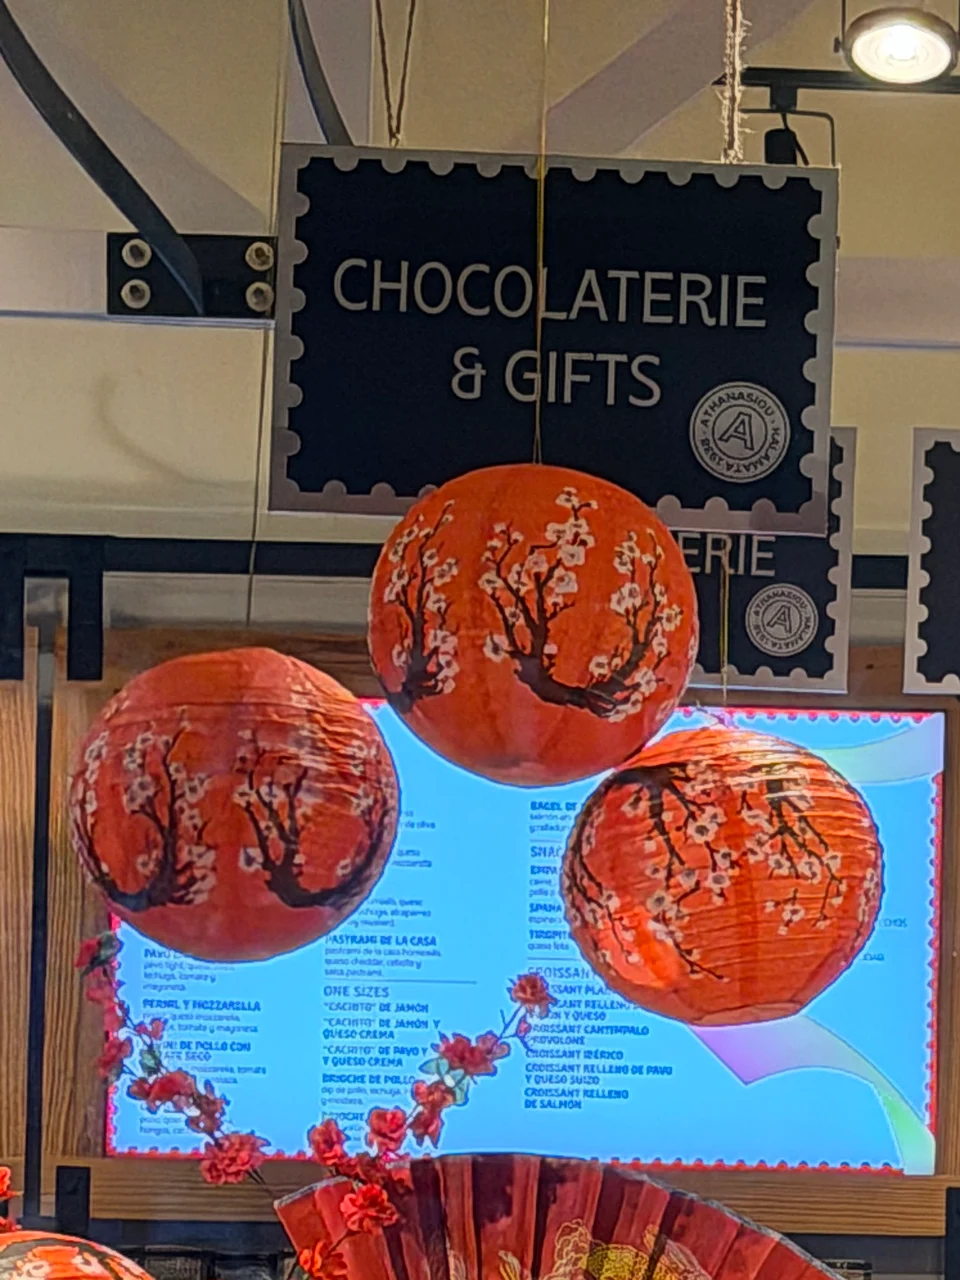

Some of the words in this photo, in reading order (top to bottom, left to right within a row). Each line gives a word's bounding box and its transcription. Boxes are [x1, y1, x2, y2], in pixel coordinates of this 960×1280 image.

[333, 257, 768, 328] CHOCOLATERIE
[450, 346, 487, 400] &
[504, 349, 662, 408] GIFTS
[700, 391, 775, 428] ATHANASIOU
[353, 986, 389, 998] SIZES
